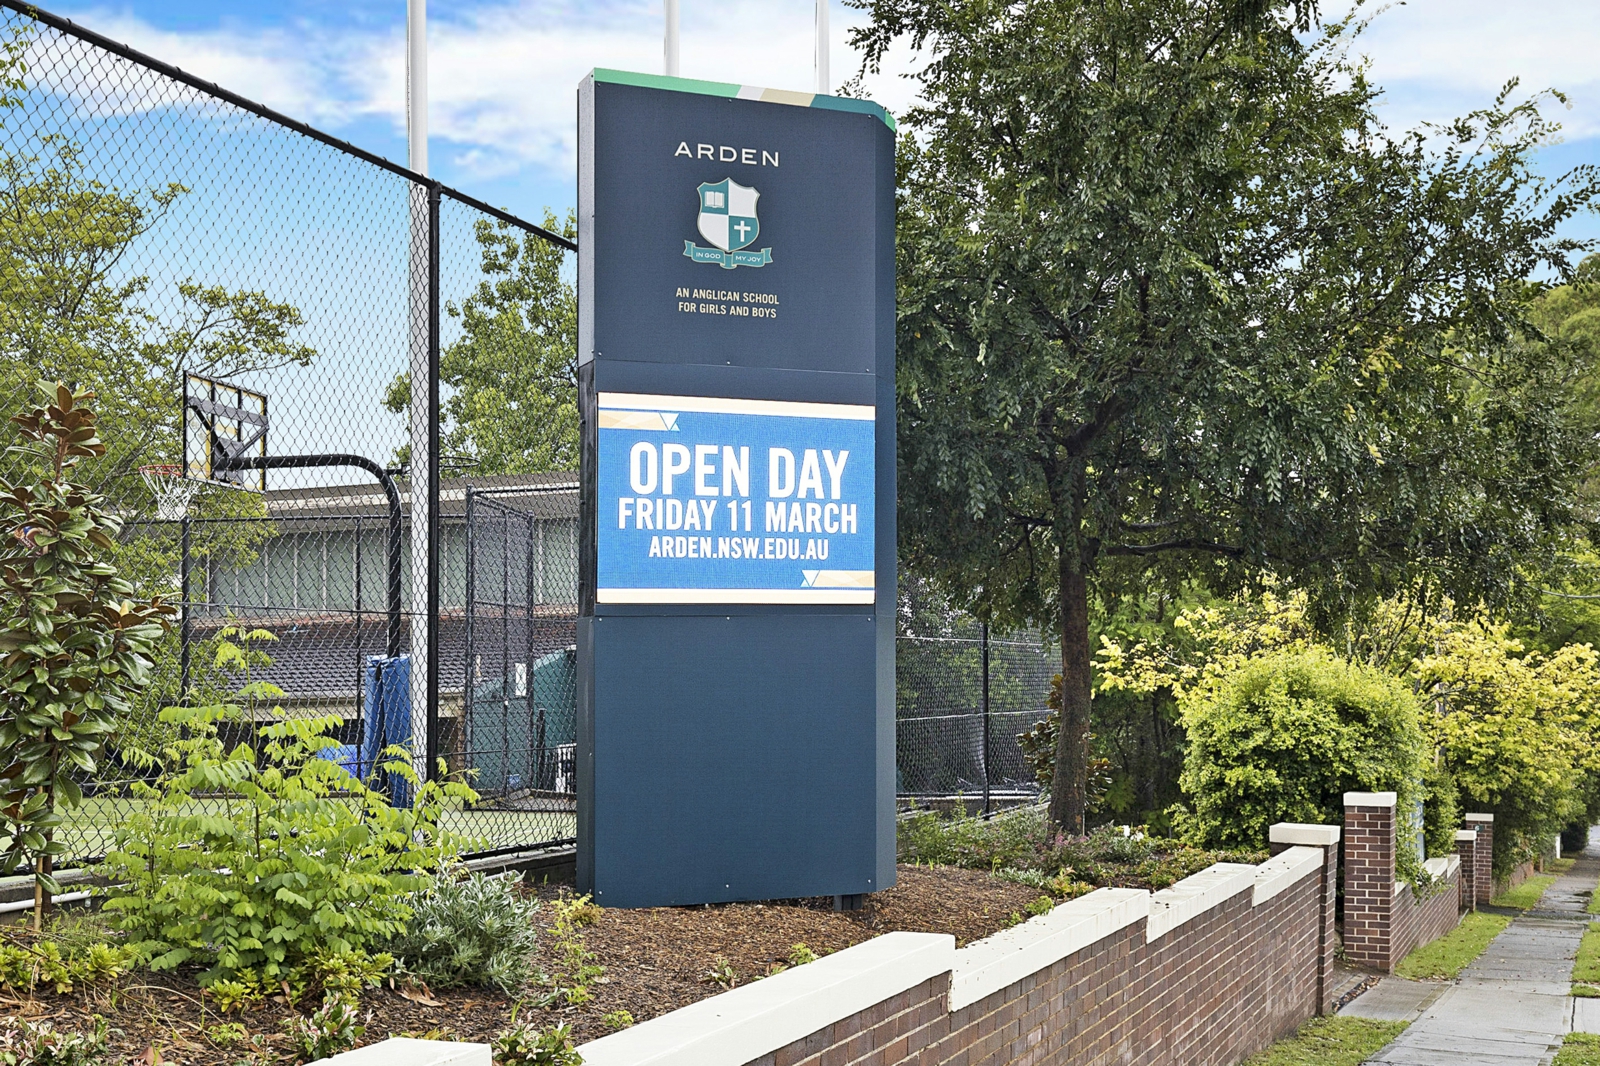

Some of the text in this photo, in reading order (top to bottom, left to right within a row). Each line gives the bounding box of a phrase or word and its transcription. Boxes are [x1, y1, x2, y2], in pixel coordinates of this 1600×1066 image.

[674, 141, 779, 167] ARDEN
[676, 287, 779, 304] AN ANGLICAN SCHOOL
[678, 302, 777, 318] FOR GIRLS AND BOYS
[629, 441, 849, 499] OPEN DAY
[618, 498, 857, 534] FRIDAY 11 MARCH
[649, 535, 829, 560] ARDEN.NSW.EDU.AU
